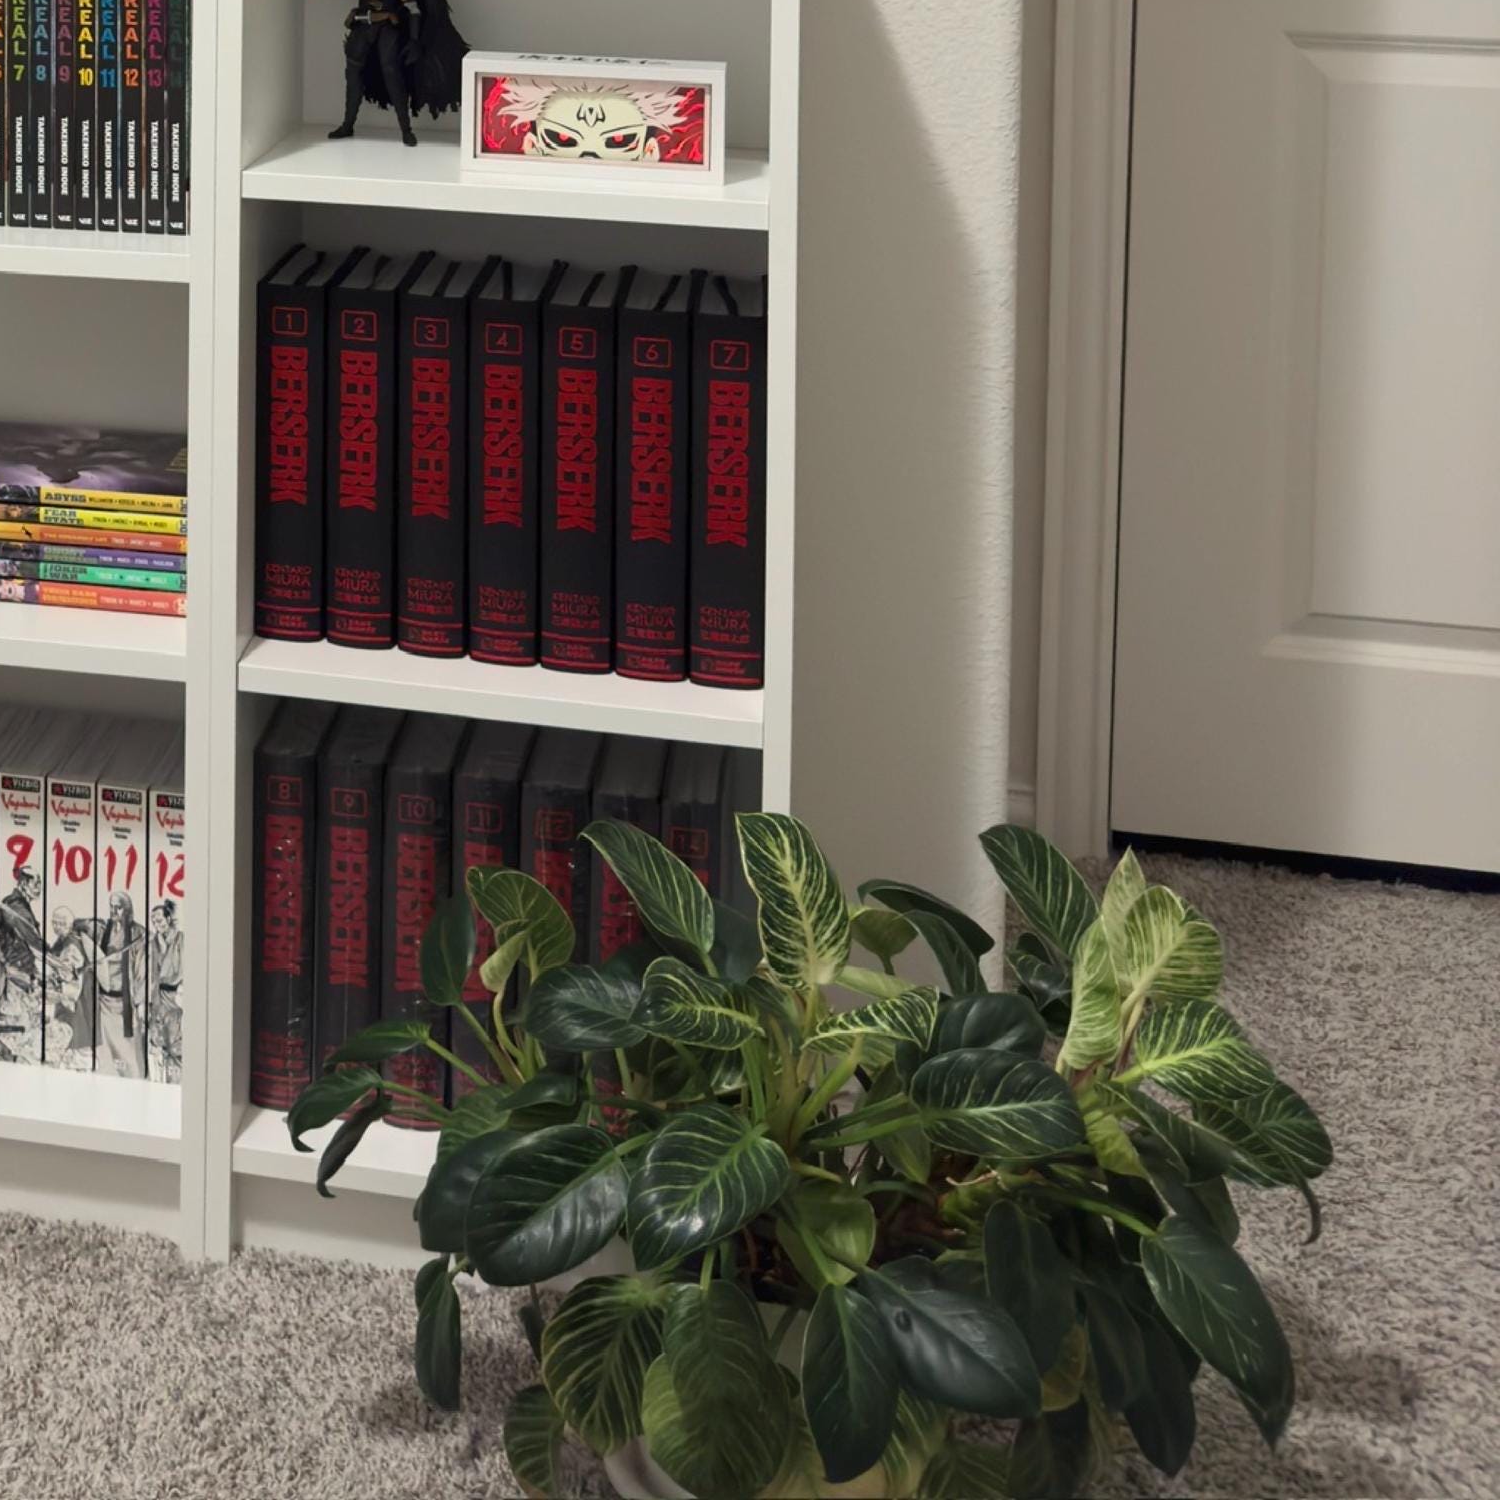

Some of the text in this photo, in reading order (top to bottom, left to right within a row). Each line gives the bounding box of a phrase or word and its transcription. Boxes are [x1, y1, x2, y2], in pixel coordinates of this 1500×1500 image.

[14, 64, 24, 80] 7
[36, 65, 46, 81] 8
[59, 65, 70, 81] 9
[79, 68, 92, 86] 10
[100, 68, 115, 88] 11
[124, 68, 139, 87] 12
[148, 68, 162, 88] 13
[172, 122, 180, 202] TAKEHIKO INOUE
[284, 314, 294, 330] 1
[354, 318, 364, 334] 2
[426, 325, 436, 342] 3
[496, 331, 508, 348] 4
[572, 334, 584, 351] 5
[646, 344, 658, 361] 6
[724, 347, 736, 364] 7
[270, 347, 308, 506] BERSERK
[338, 350, 378, 512] BERSERK
[411, 358, 450, 520] BERSERK
[484, 364, 523, 528] BERSERK
[557, 367, 597, 533] BERSERK
[630, 377, 672, 544] BERSERK
[708, 380, 750, 548] BERSERK
[626, 614, 675, 628] MIURA
[280, 783, 290, 800] 8
[1, 794, 40, 810] Vagabond
[52, 800, 92, 816] Vagabond
[102, 804, 142, 822] Vagabond
[6, 834, 34, 880] 9
[53, 838, 92, 886] 10
[104, 844, 138, 892] 11
[156, 852, 184, 898] 12
